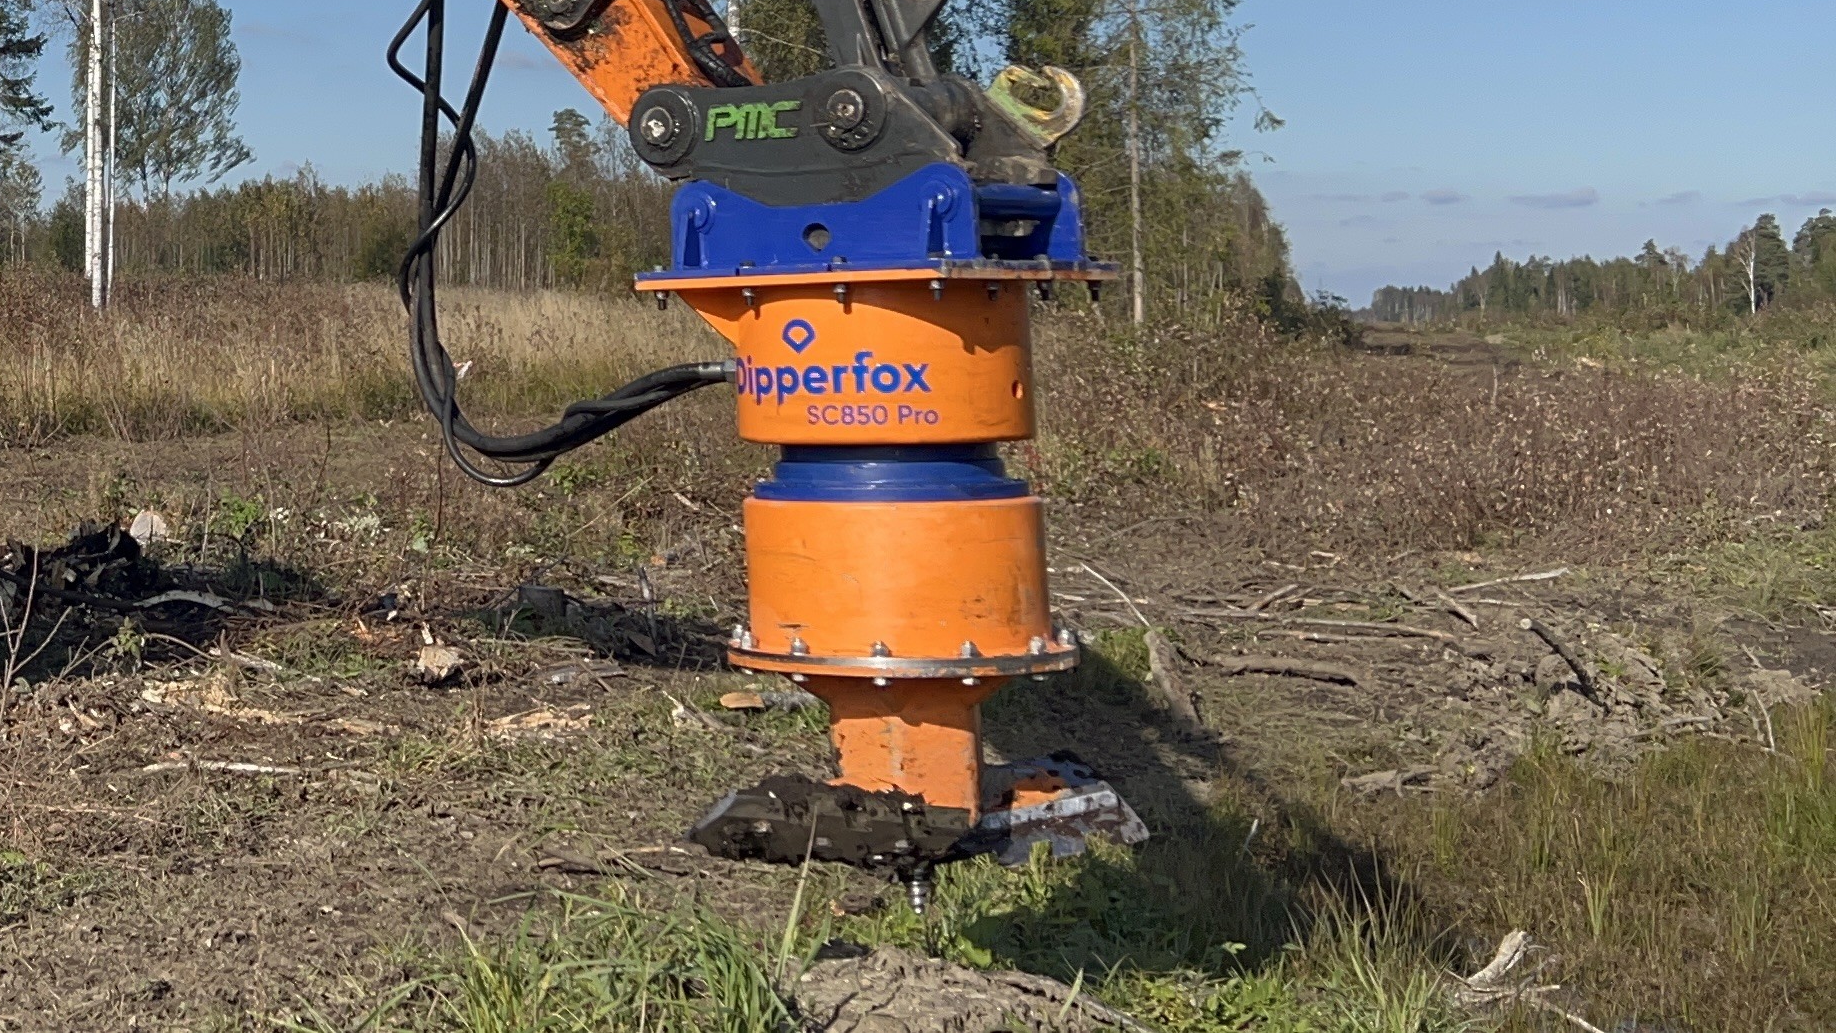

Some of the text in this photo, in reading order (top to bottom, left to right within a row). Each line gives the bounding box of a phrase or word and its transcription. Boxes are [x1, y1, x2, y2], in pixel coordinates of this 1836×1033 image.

[705, 100, 802, 142] PMC
[736, 351, 932, 406] Dipperfox
[806, 405, 939, 426] SC850 Pro
